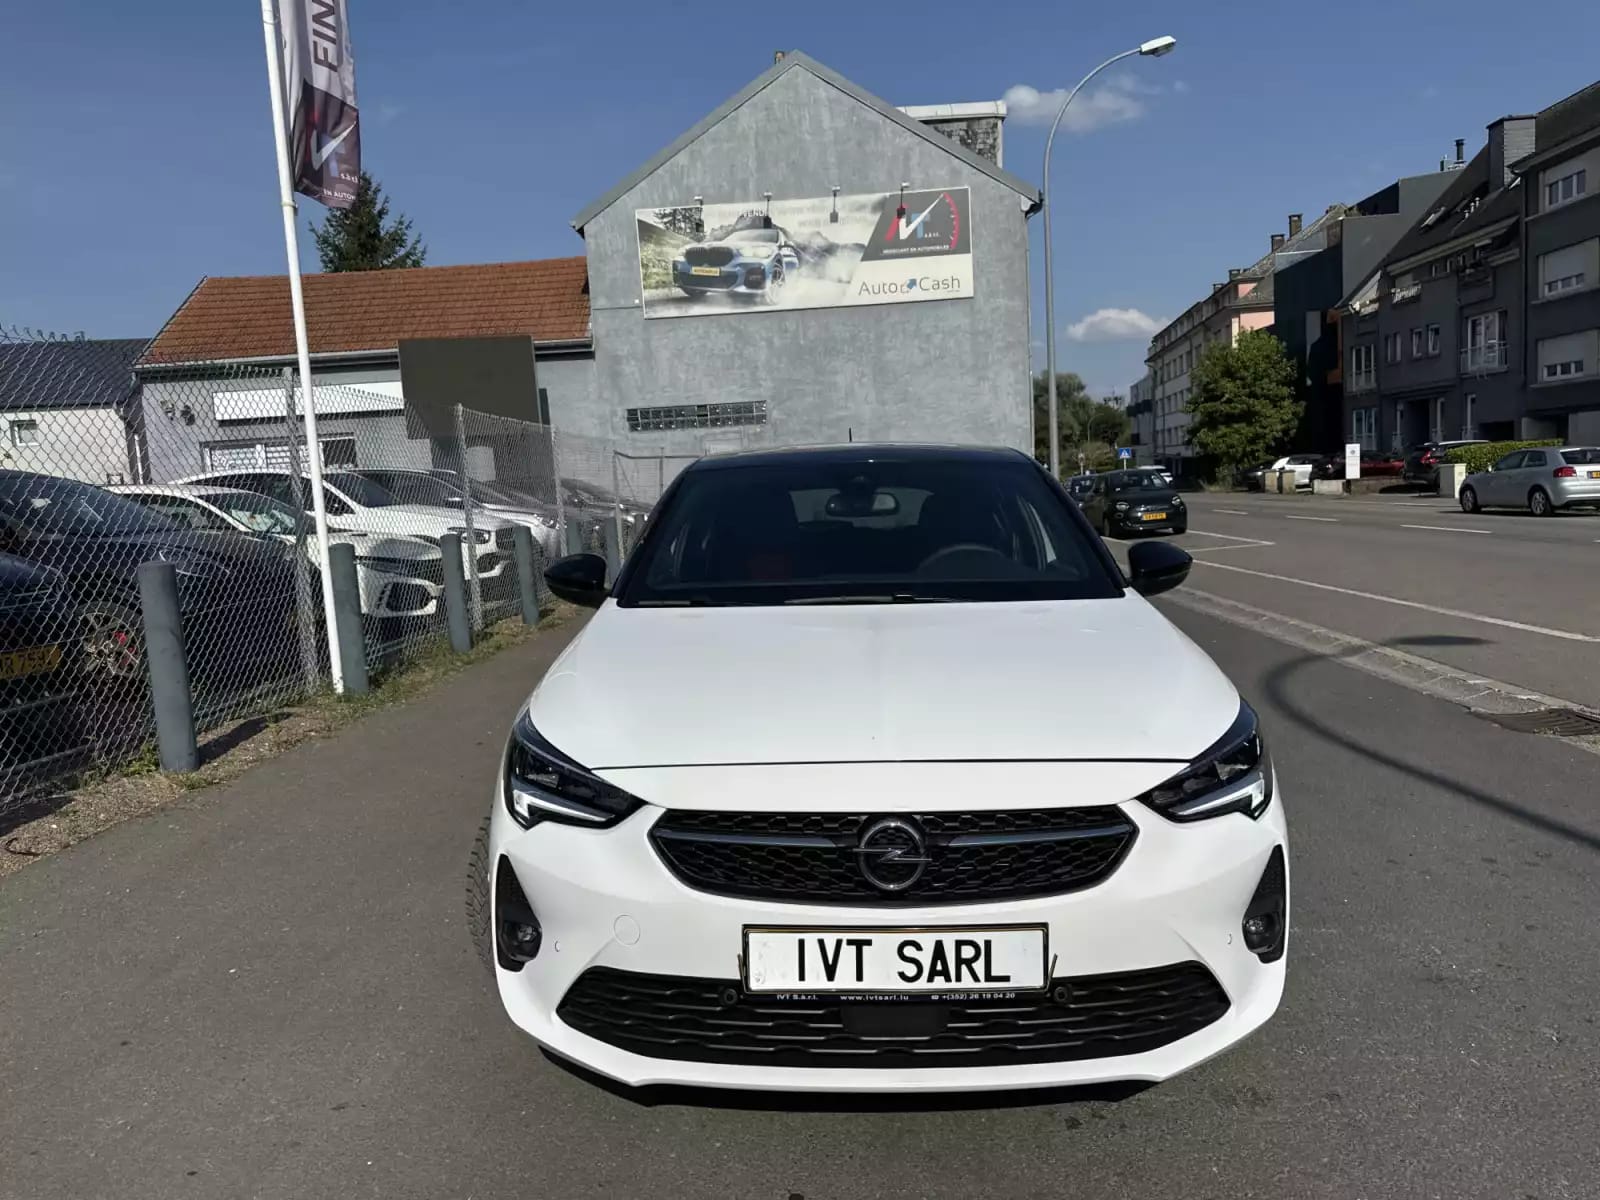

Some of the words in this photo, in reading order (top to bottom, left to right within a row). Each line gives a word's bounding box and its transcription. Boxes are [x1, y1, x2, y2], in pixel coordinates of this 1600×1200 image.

[312, 0, 337, 72] FIN
[858, 281, 898, 296] Auto
[919, 275, 961, 291] Cash
[798, 938, 872, 982] IVT
[897, 939, 1011, 983] SARL
